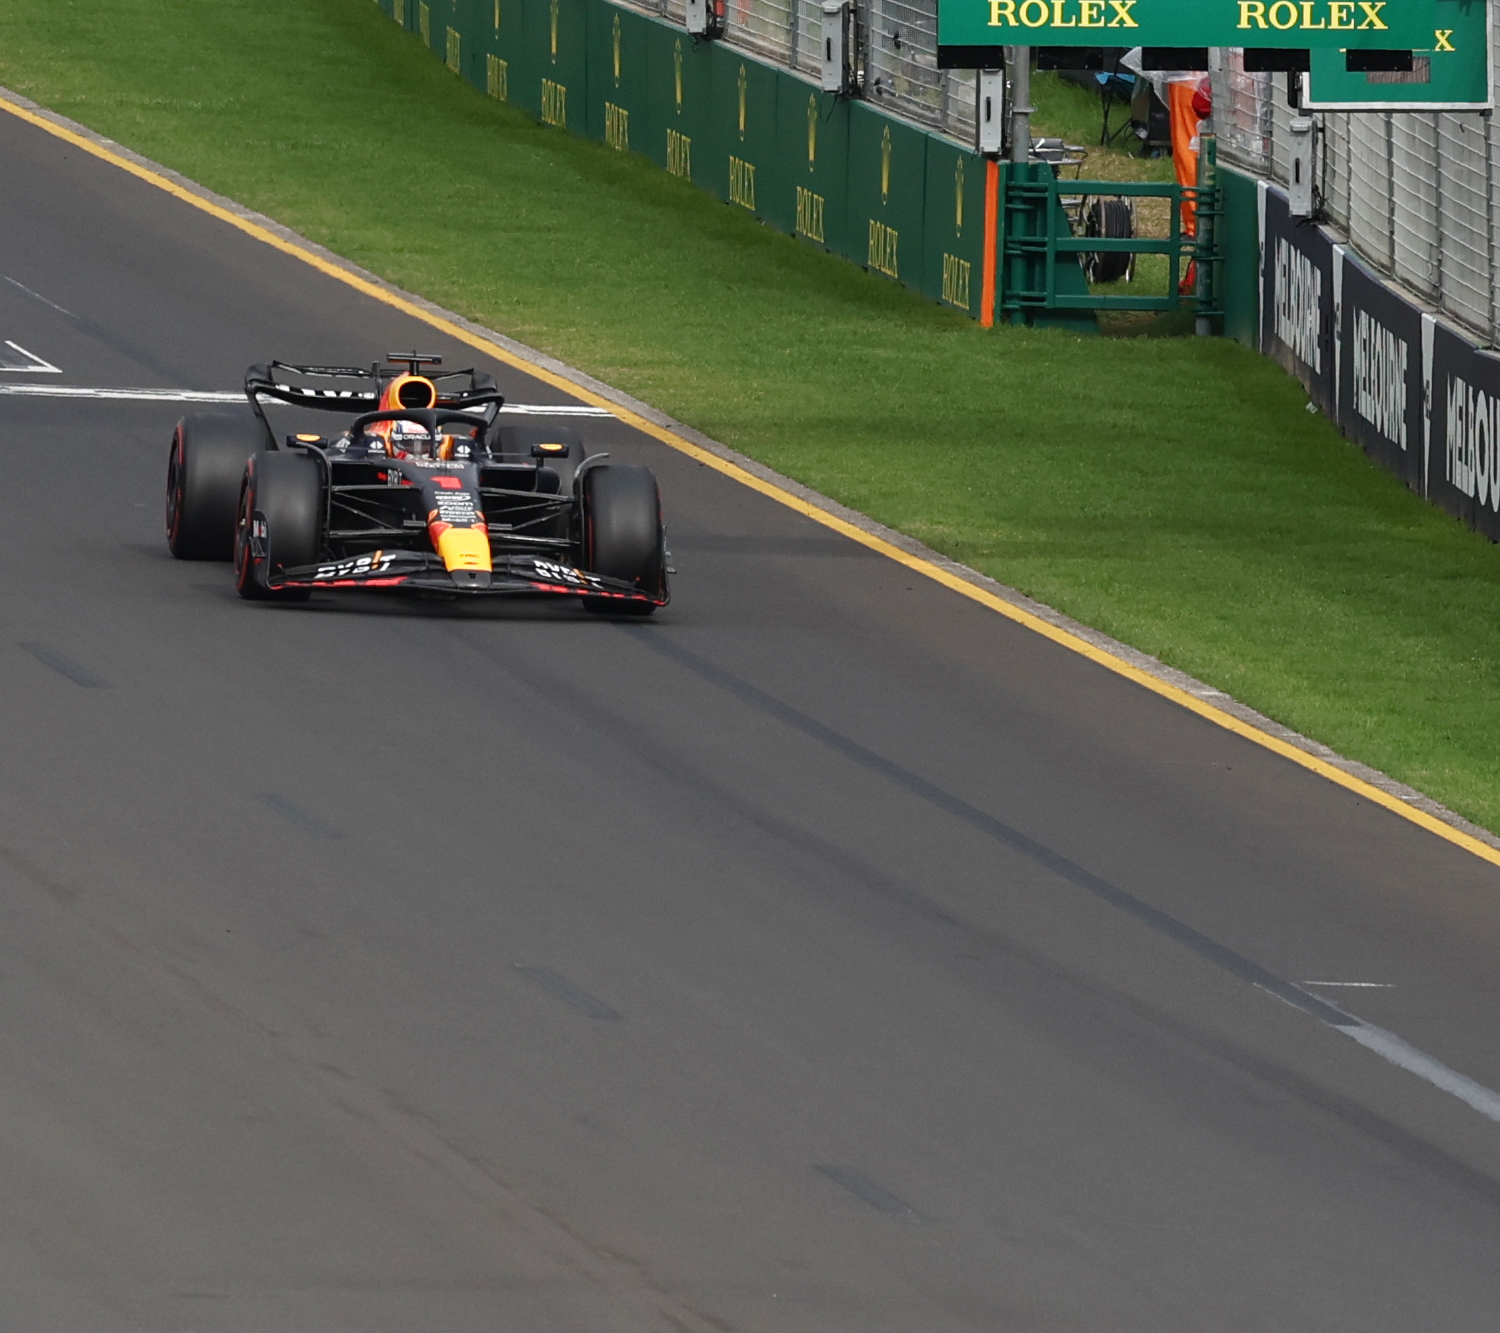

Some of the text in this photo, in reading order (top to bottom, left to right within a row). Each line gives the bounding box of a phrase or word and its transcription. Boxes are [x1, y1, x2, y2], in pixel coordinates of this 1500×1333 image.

[1237, 0, 1388, 31] ROLEX
[604, 101, 629, 153] ROLEX
[666, 128, 692, 182] ROLEX
[729, 155, 756, 211] ROLEX
[796, 185, 825, 244] ROLEX
[868, 218, 899, 279] ROLEX
[942, 251, 972, 311] ROLEX
[1353, 306, 1408, 451] MELBOURNE
[430, 475, 463, 490] 1
